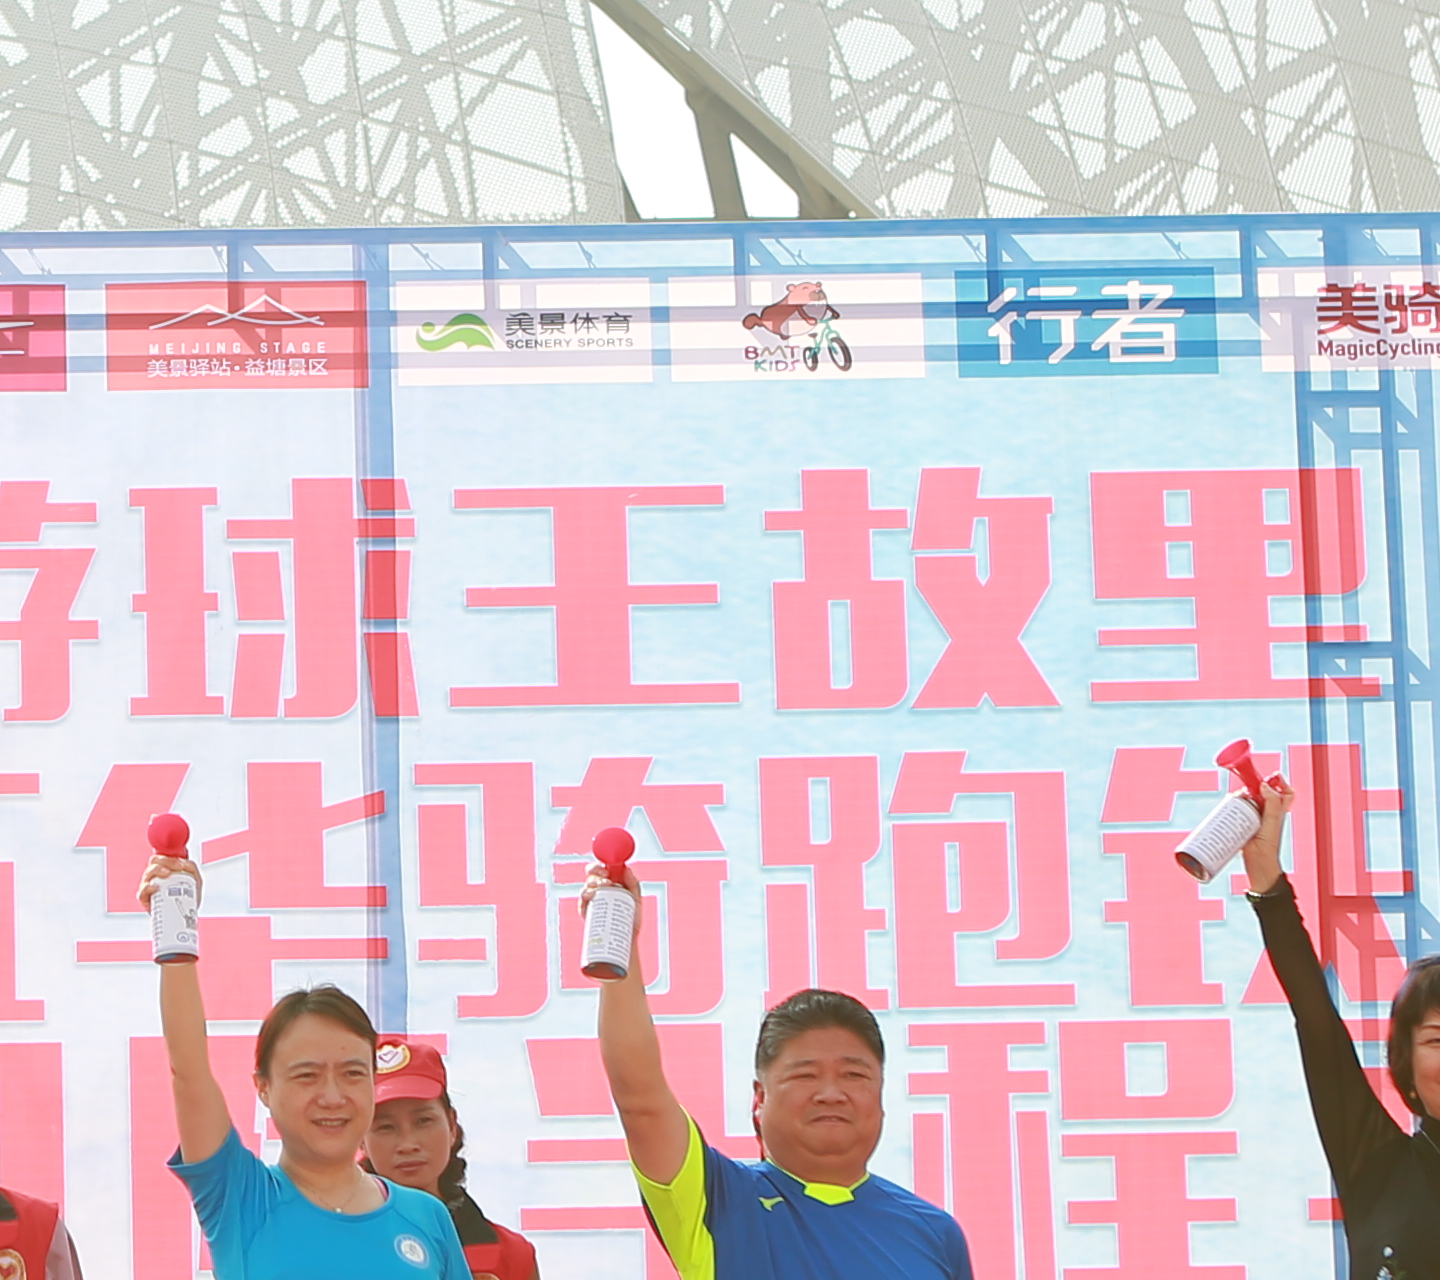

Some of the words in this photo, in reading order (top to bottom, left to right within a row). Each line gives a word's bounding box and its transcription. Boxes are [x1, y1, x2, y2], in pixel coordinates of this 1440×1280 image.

[505, 311, 634, 337] 美景体育
[987, 280, 1185, 365] 行者
[149, 341, 241, 355] MEIJING
[260, 340, 327, 355] STAGE
[505, 337, 573, 350] SCENERY
[577, 336, 634, 349] SPORTS
[744, 346, 800, 360] BMT
[754, 359, 800, 372] KIDS
